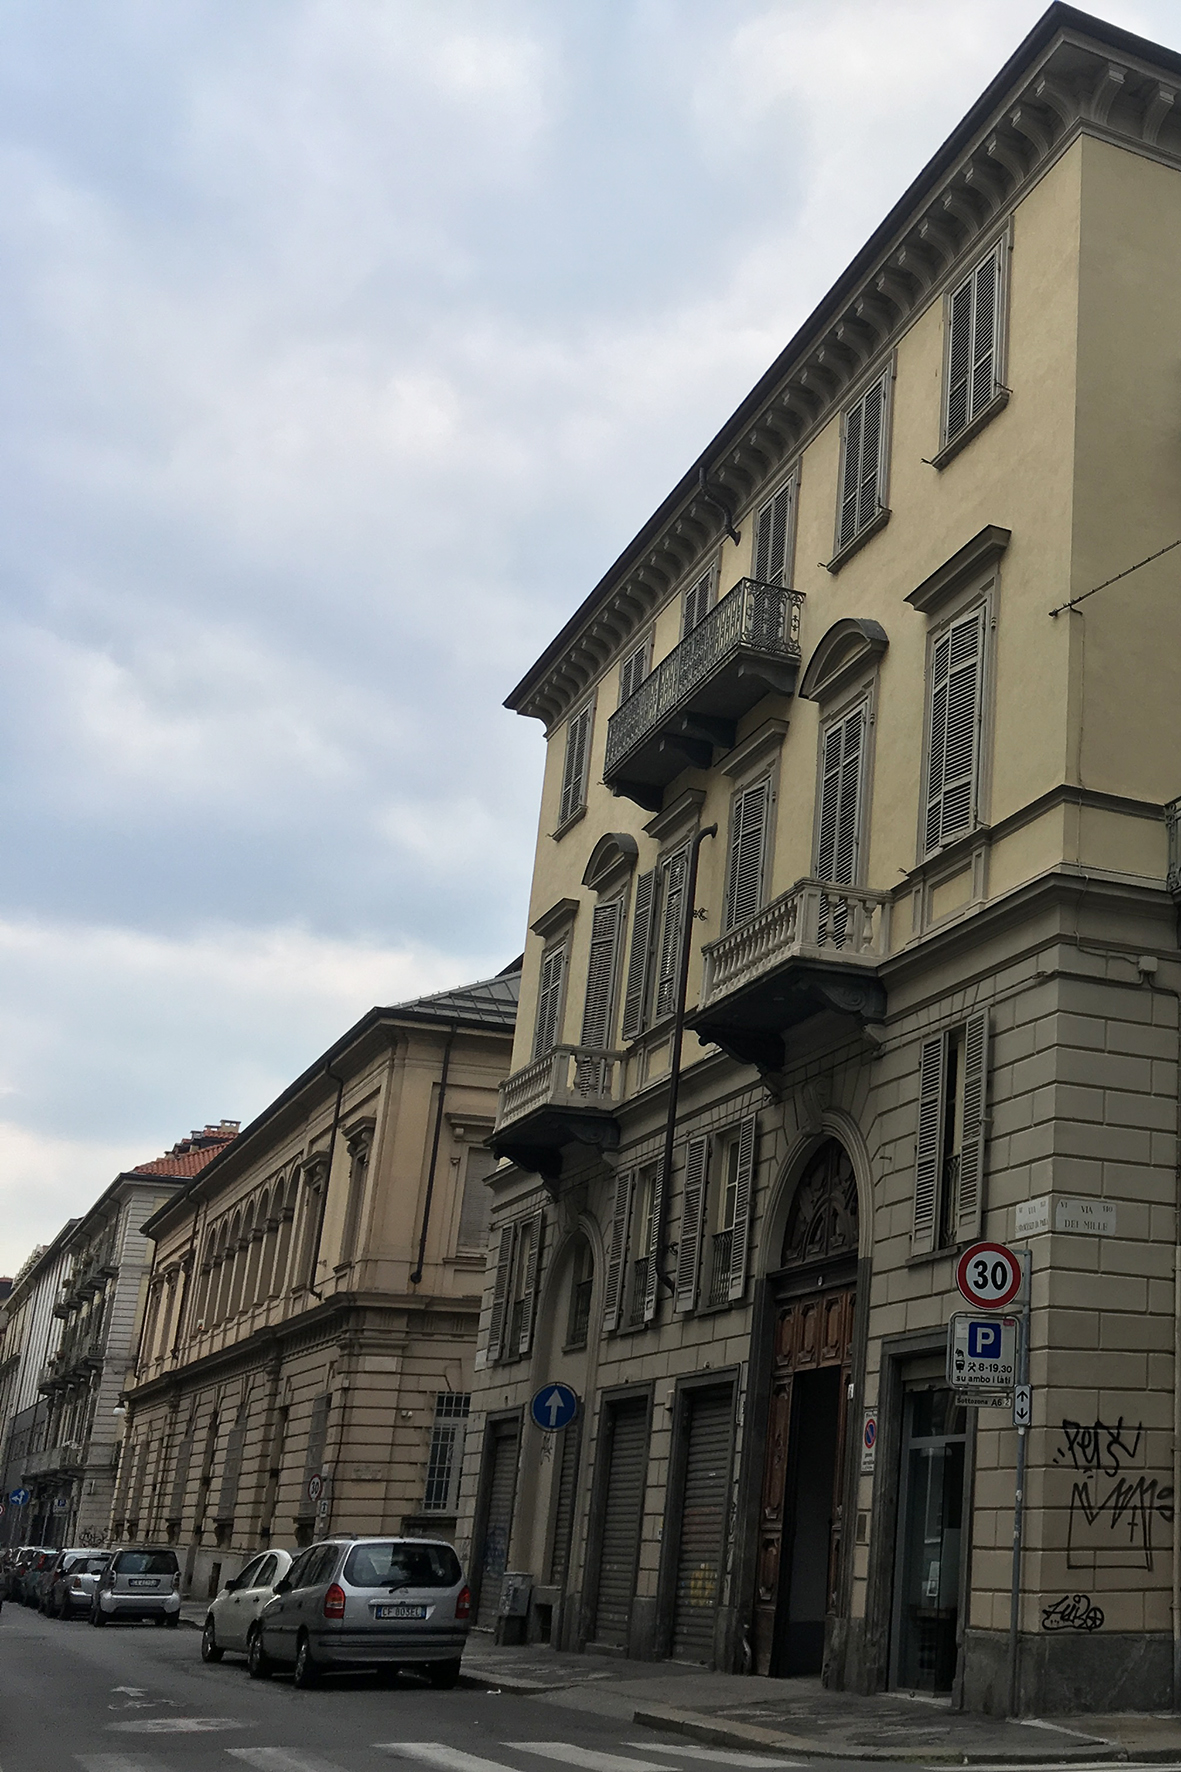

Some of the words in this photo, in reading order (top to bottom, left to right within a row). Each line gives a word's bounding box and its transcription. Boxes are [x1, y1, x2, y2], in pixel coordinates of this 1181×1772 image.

[1081, 1205, 1093, 1214] VIA
[1064, 1219, 1079, 1229] DEI
[1083, 1220, 1108, 1231] MILLE
[972, 1259, 1008, 1291] 30
[976, 1326, 995, 1354] P
[968, 1375, 991, 1383] ambo
[997, 1375, 1011, 1384] lati
[957, 1397, 988, 1405] Sottozona
